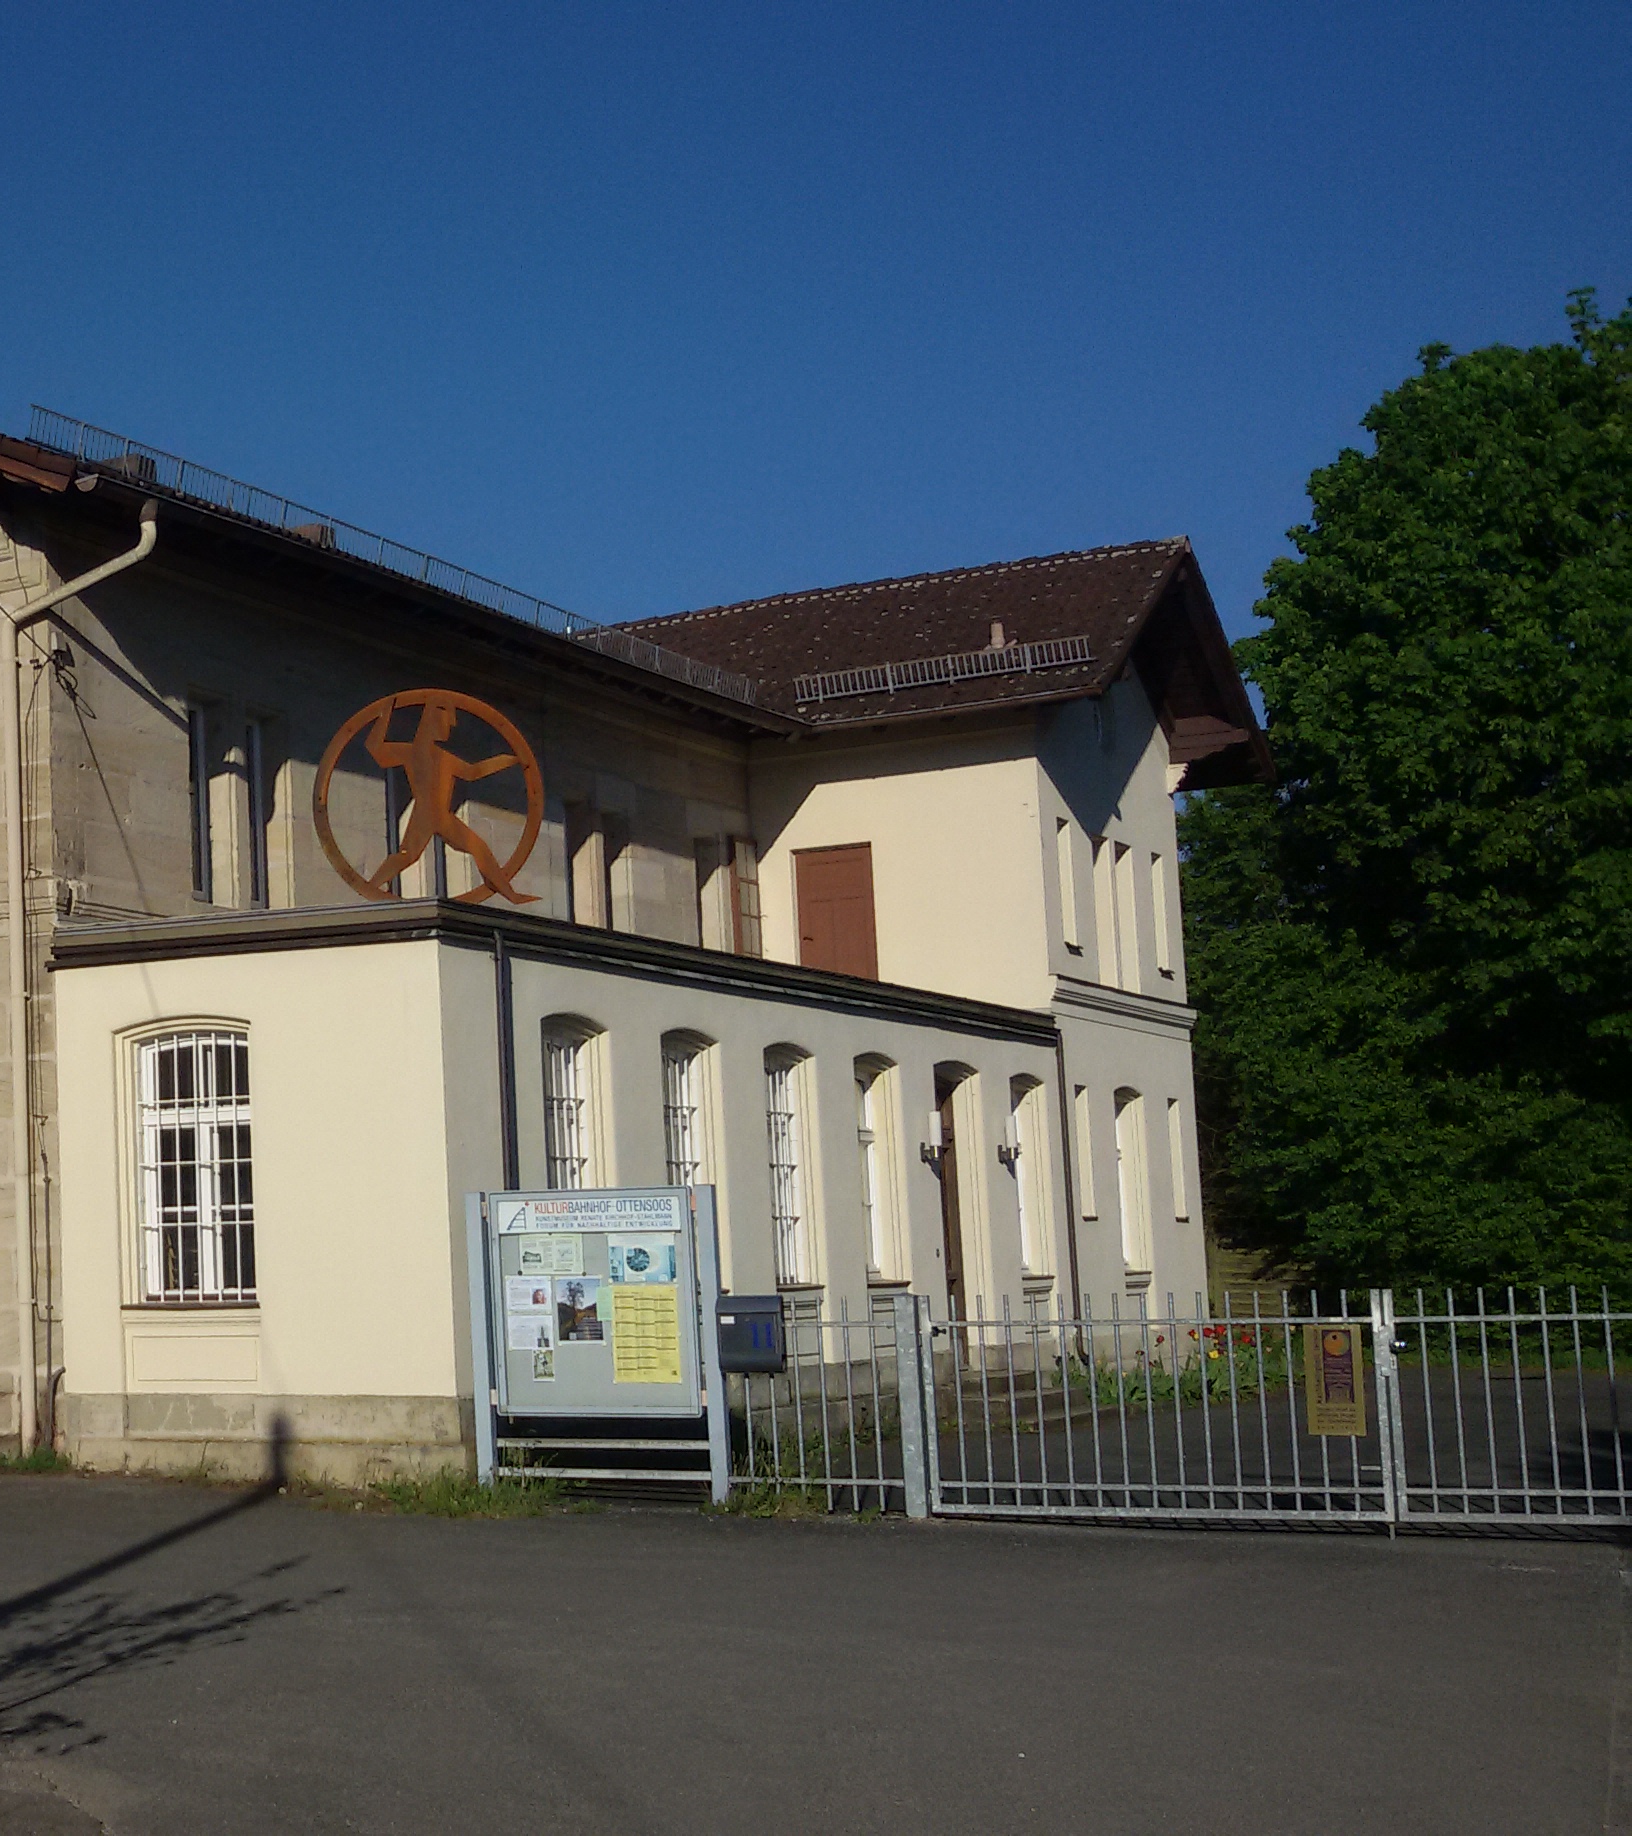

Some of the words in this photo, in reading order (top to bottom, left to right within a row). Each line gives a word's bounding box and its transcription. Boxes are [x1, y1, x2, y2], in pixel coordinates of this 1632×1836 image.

[534, 1201, 611, 1214] KULTURBAHNHOF
[616, 1199, 672, 1212] OTTENSOOS
[750, 1322, 773, 1349] 11
